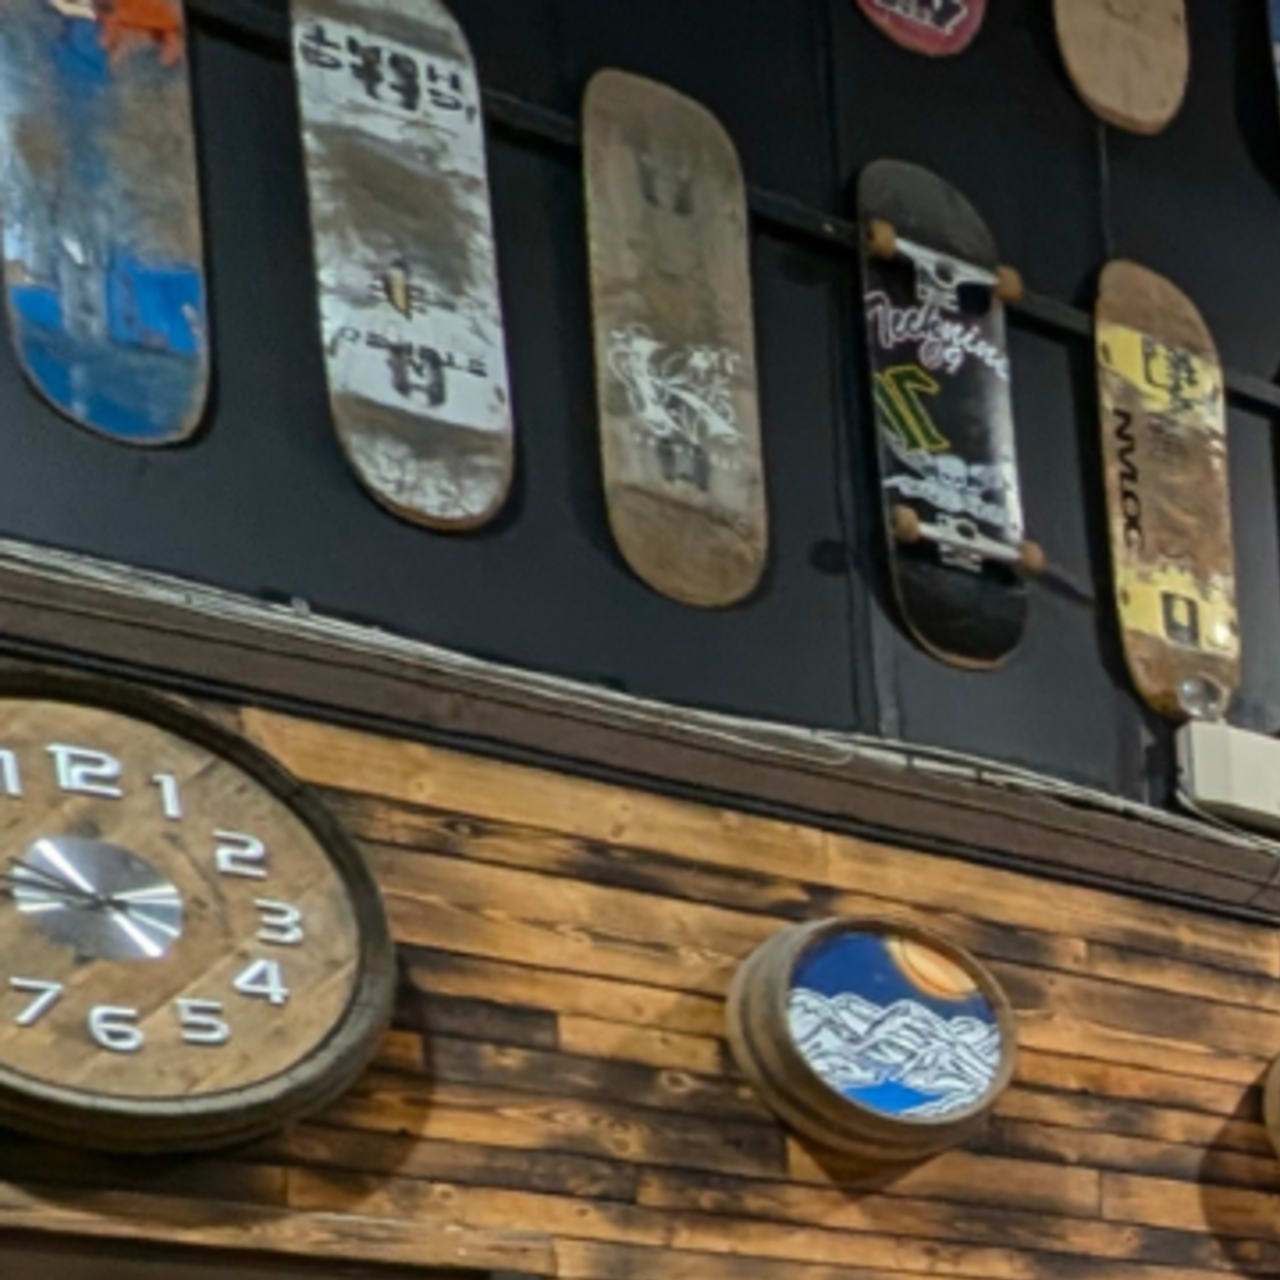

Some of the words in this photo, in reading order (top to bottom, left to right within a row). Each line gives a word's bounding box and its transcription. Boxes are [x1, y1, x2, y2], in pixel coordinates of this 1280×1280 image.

[45, 742, 123, 798] 12
[152, 773, 182, 820] 1
[211, 828, 268, 880] 2
[253, 897, 304, 945] 3
[8, 975, 64, 1028] 7
[233, 957, 290, 1005] 4
[87, 1005, 144, 1053] 6
[173, 995, 231, 1046] 5
